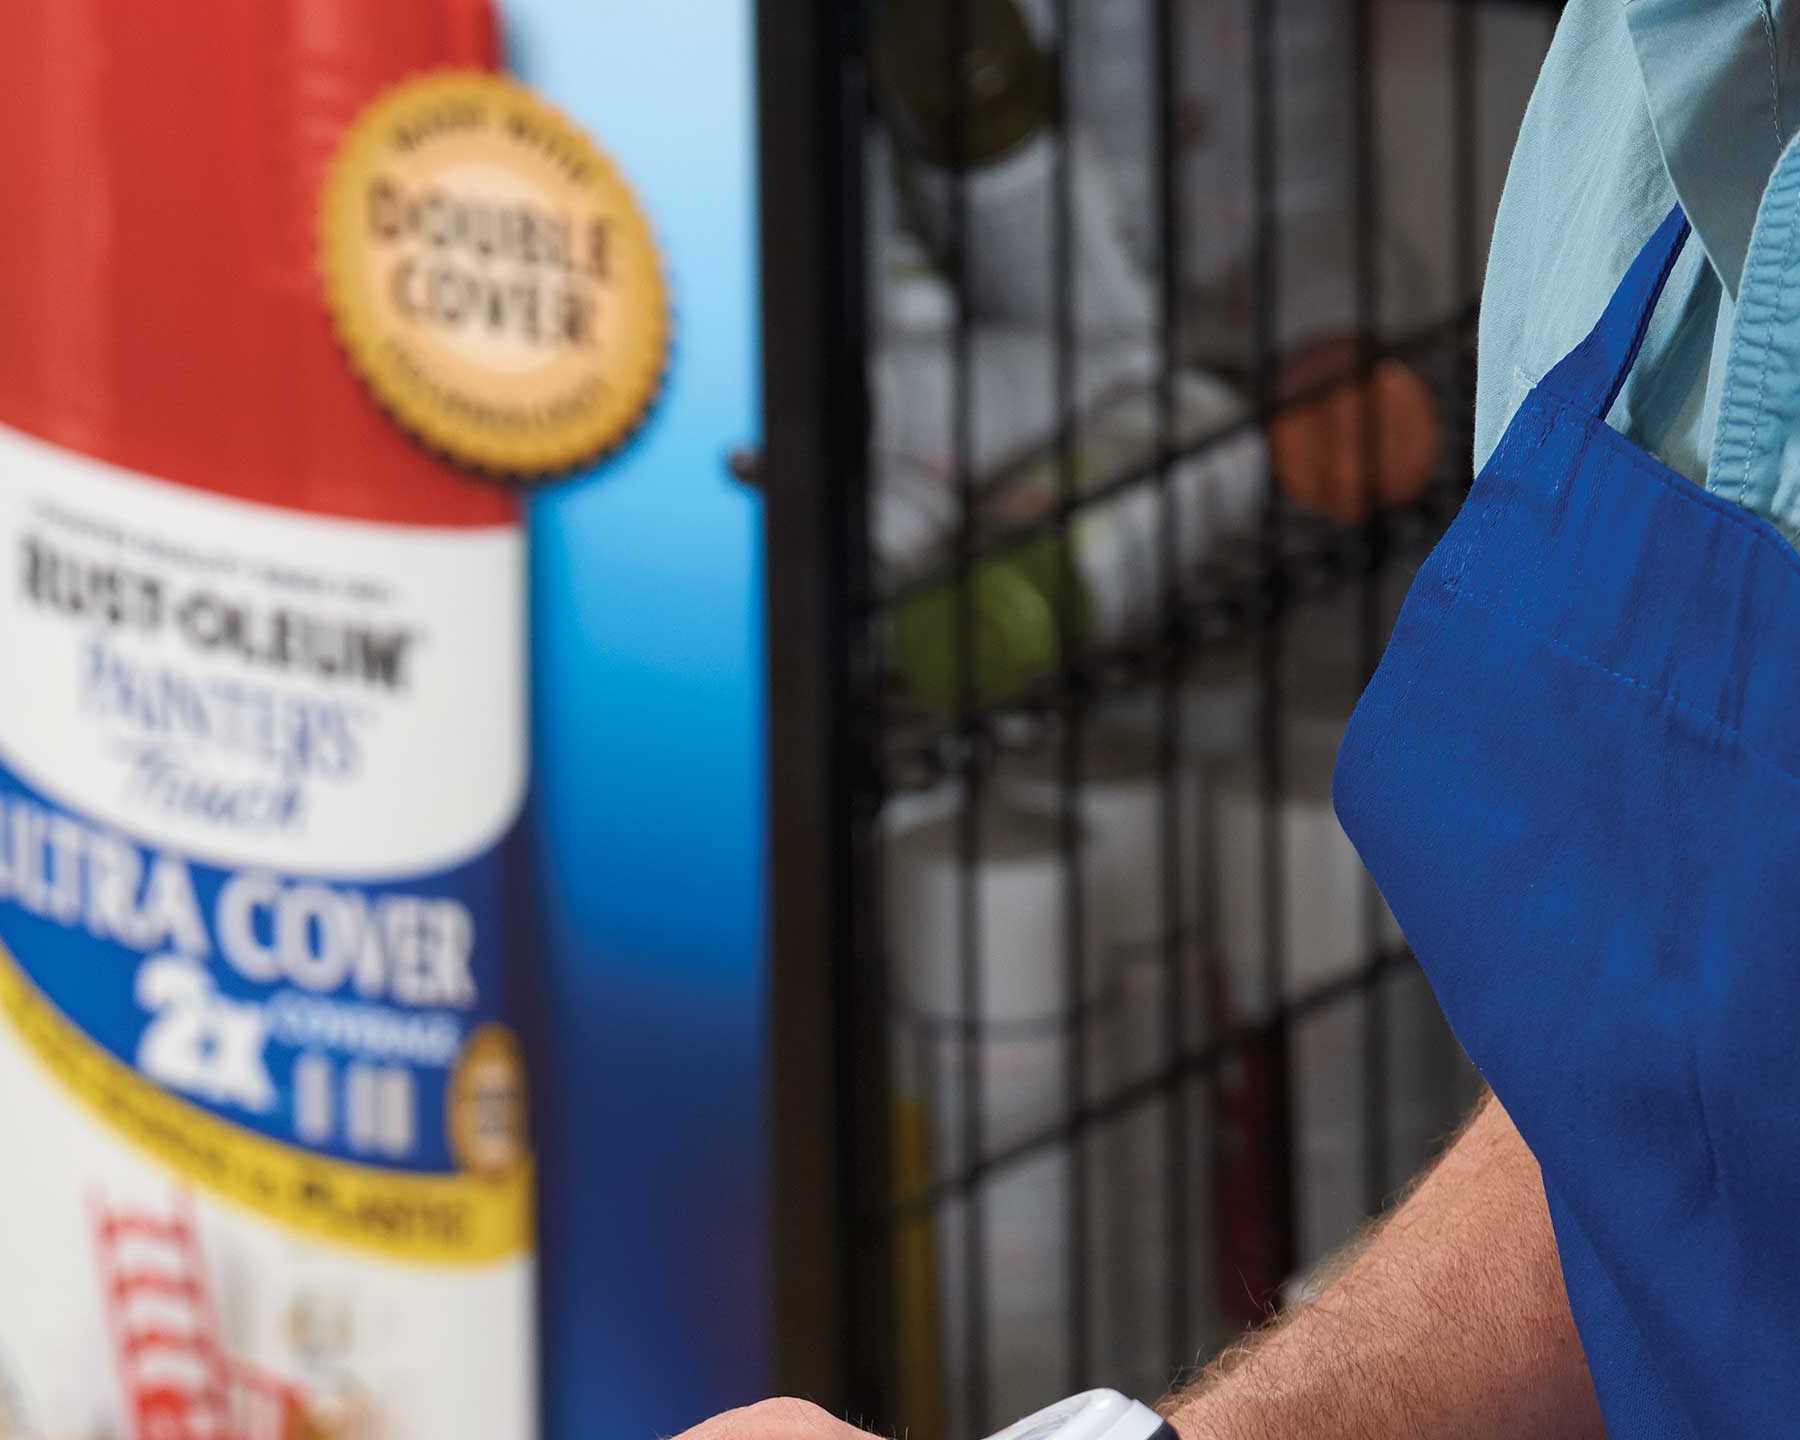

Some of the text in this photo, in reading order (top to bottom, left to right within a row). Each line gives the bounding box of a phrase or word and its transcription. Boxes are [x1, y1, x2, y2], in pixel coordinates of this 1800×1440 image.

[363, 172, 613, 280] DOUBLE
[390, 254, 594, 350] COVER
[214, 866, 479, 1010] COVER
